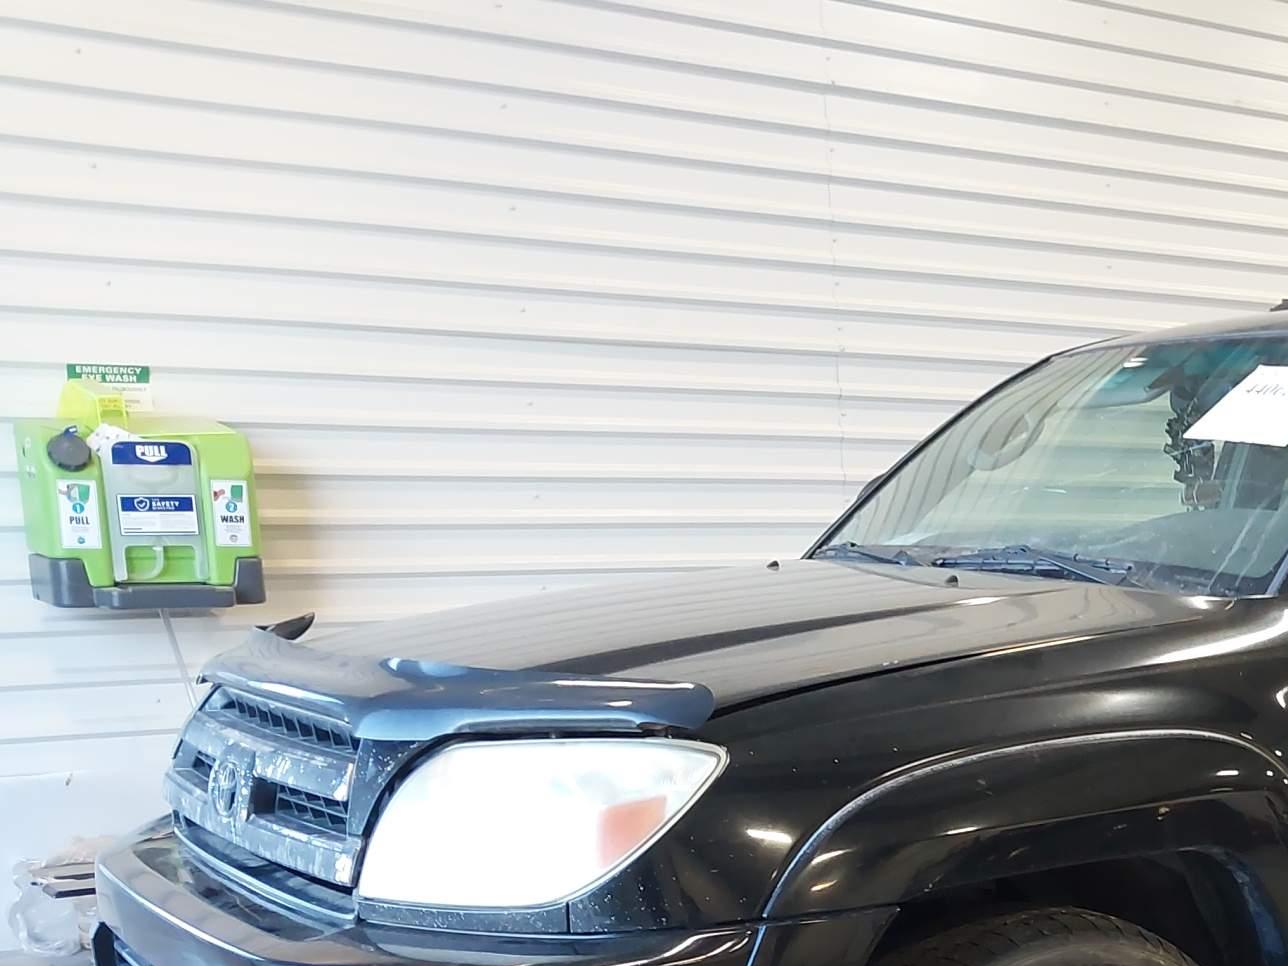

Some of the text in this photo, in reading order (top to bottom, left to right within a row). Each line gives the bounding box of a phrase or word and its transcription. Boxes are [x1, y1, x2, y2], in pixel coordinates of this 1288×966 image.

[75, 365, 142, 375] EMERGENCY
[105, 374, 137, 383] WASH
[135, 445, 168, 457] PULL
[69, 516, 90, 525] PULL
[220, 515, 245, 524] WASH
